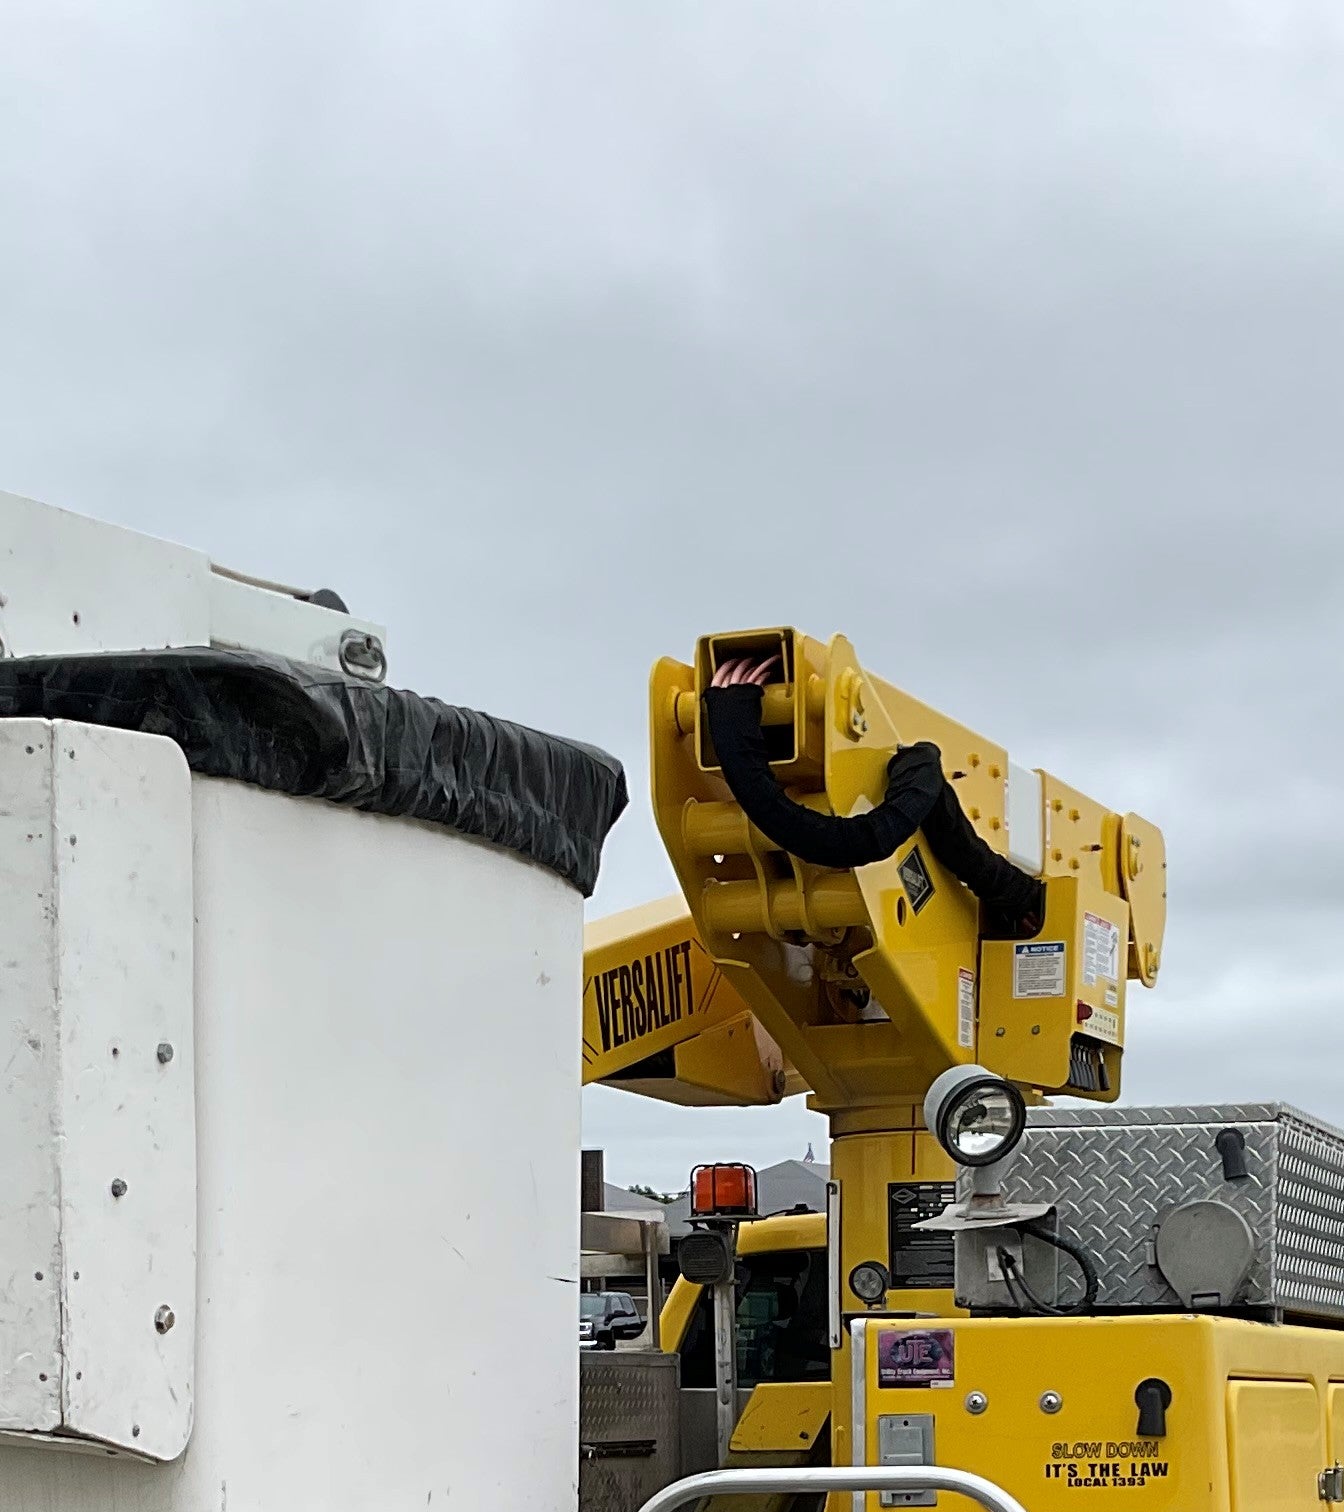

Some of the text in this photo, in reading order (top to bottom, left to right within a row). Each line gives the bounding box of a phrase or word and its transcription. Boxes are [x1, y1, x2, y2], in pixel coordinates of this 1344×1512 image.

[594, 940, 693, 1053] VERSALIFT
[1052, 1441, 1158, 1459] SLOW DOWN
[1045, 1462, 1169, 1478] IT'S THE LAW
[1067, 1477, 1146, 1487] LOCAL 1393
